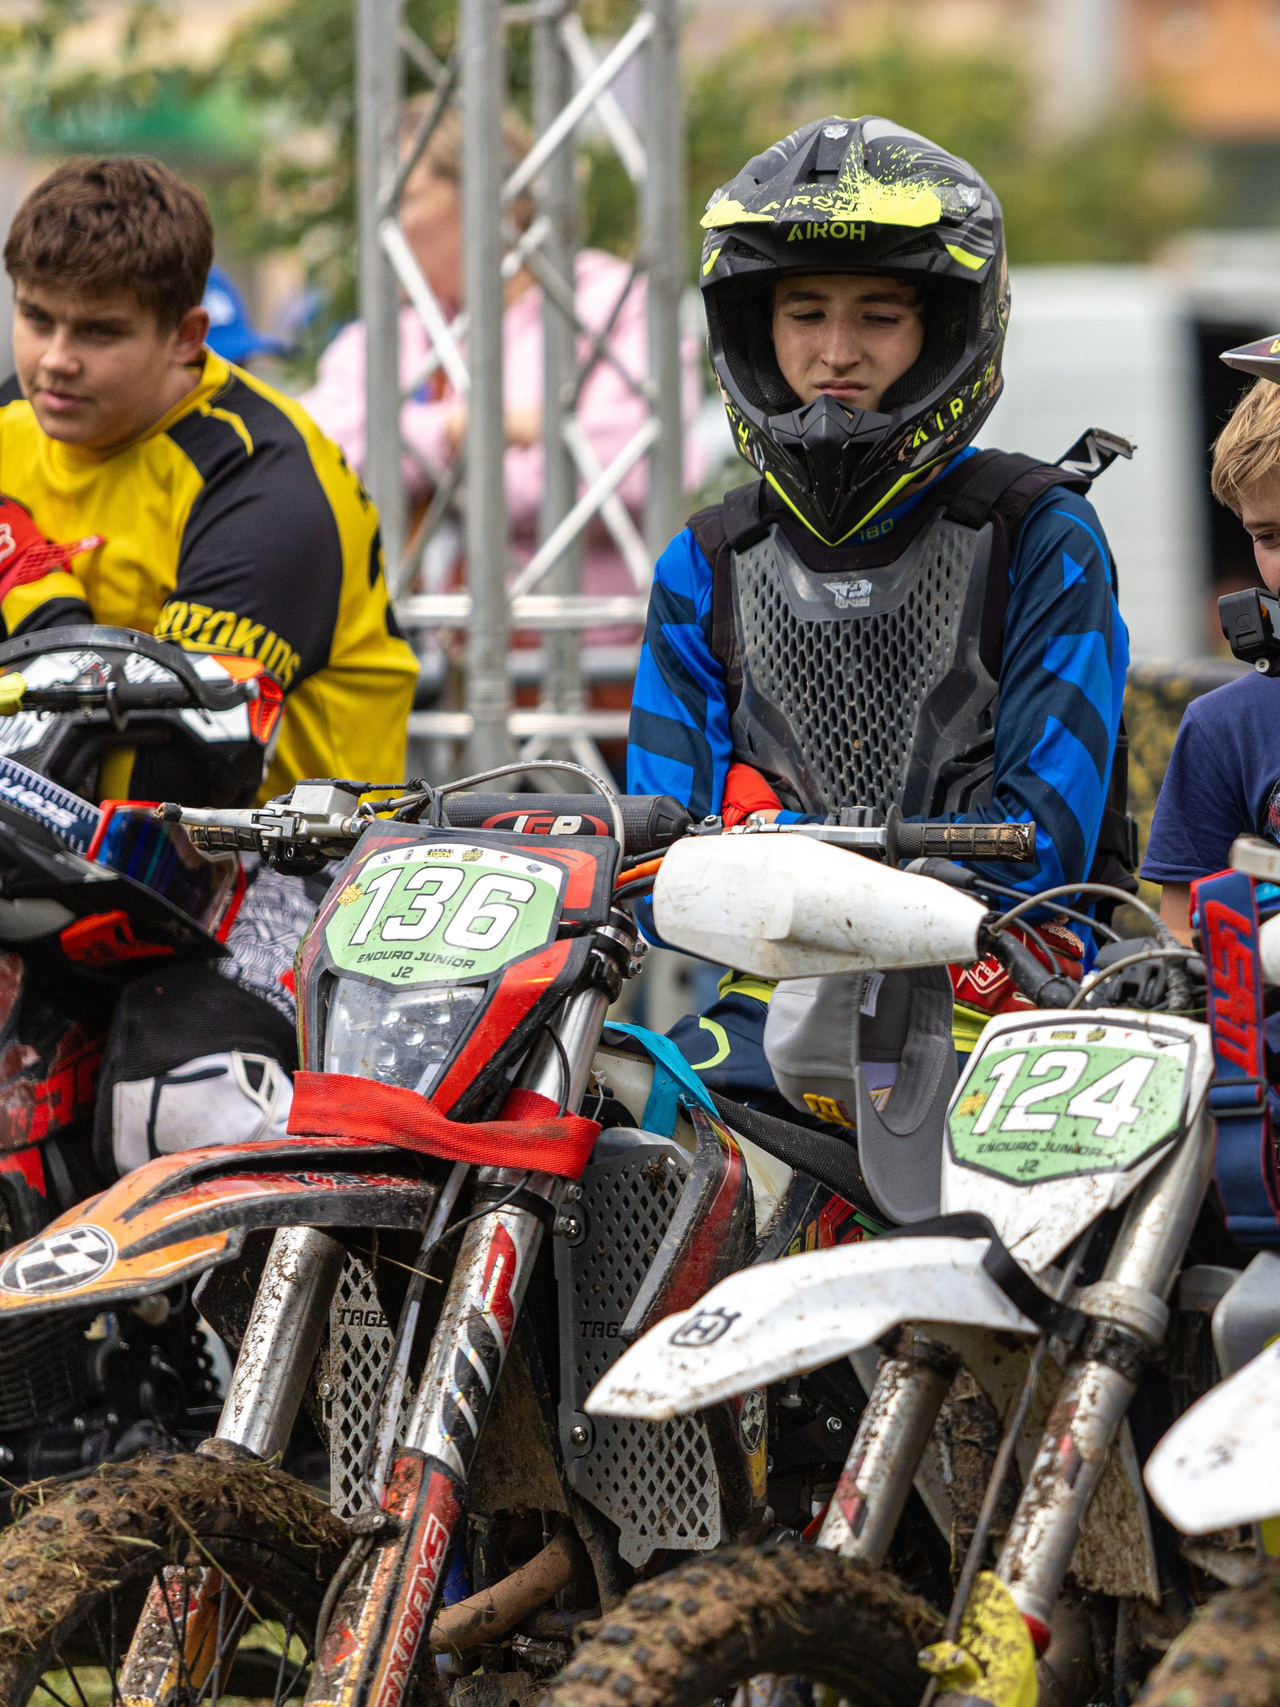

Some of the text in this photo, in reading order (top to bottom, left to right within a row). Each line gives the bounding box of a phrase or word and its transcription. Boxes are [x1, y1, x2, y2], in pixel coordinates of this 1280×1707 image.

[787, 221, 866, 242] AIROH
[858, 517, 894, 541] 180
[153, 600, 301, 690] OTOKIDS
[348, 865, 537, 951] 136
[356, 949, 476, 970] ENDURO JUNIOR
[391, 966, 414, 979] J2
[970, 1049, 1158, 1139] 124
[976, 1141, 1037, 1154] ENDURO
[1016, 1159, 1039, 1174] J2
[579, 1320, 623, 1339] TAG
